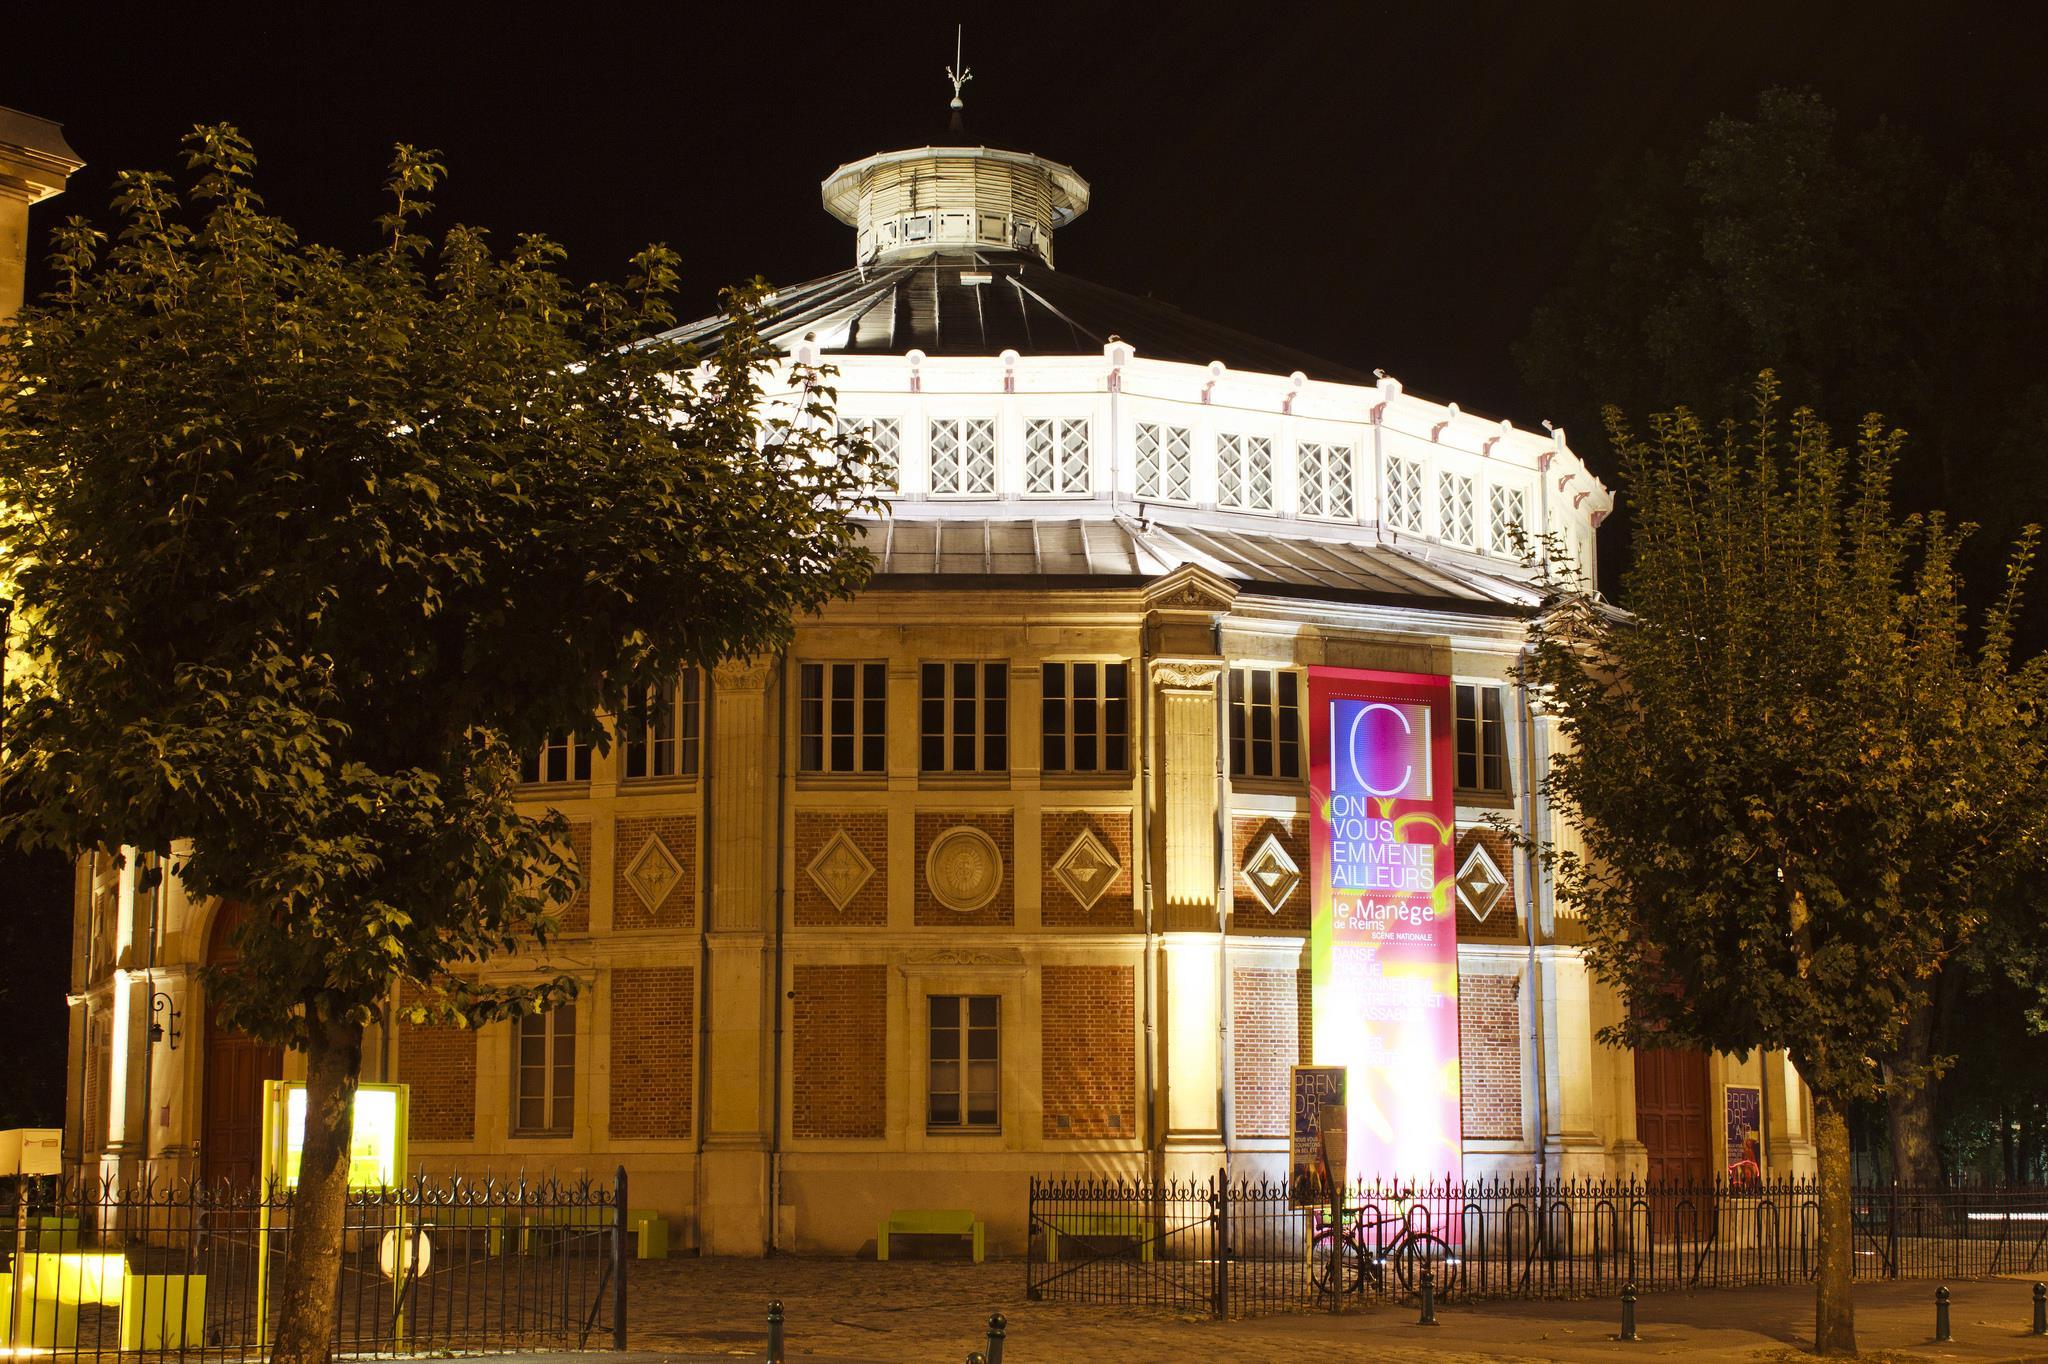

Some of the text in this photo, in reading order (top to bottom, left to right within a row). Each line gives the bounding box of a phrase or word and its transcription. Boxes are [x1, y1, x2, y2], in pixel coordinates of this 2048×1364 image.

[1330, 702, 1431, 797] ICI
[1332, 795, 1365, 816] ON
[1332, 818, 1394, 842] VOUS
[1332, 865, 1434, 889] AILLEURS
[1333, 898, 1434, 925] le Manège
[1334, 917, 1384, 931] de Reims
[1396, 932, 1433, 942] NATIONALE
